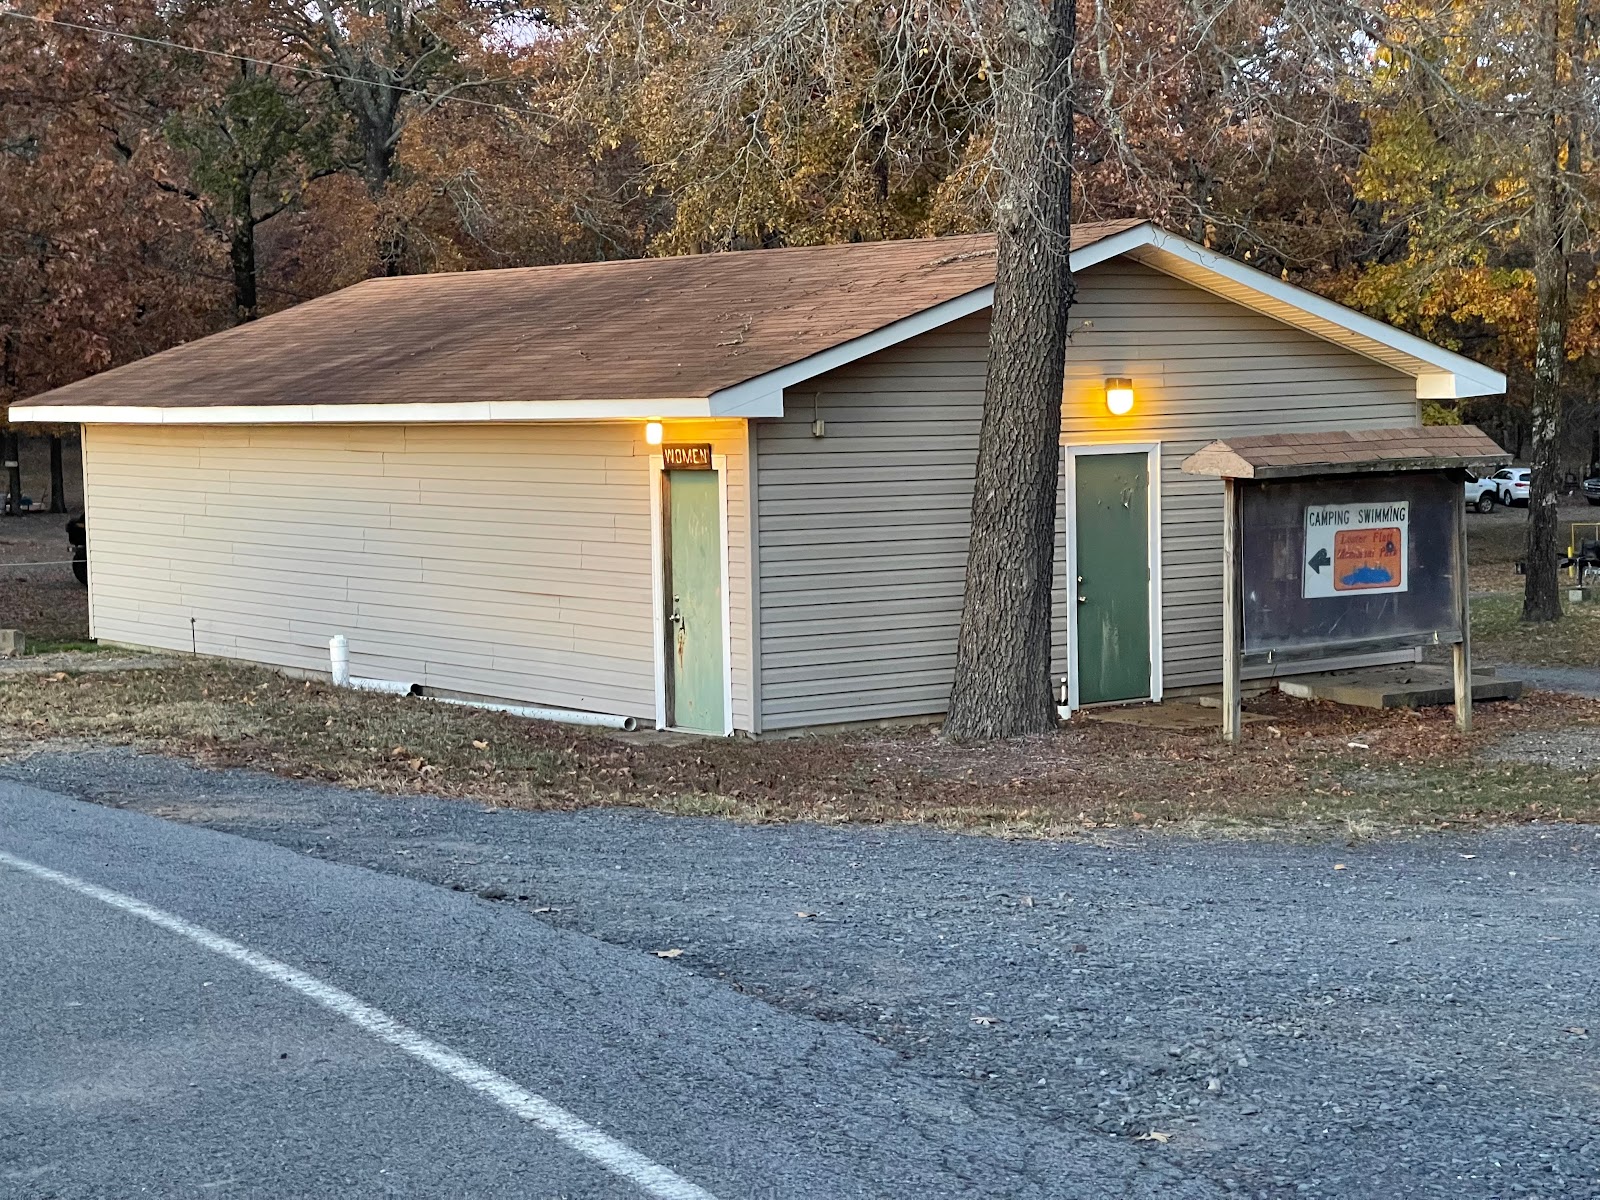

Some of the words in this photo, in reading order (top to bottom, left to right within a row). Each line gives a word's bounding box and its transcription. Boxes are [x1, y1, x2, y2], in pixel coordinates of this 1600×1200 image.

[664, 448, 708, 464] WOMEN
[1309, 510, 1350, 526] CAMPING
[1358, 507, 1406, 524] SWIMMING
